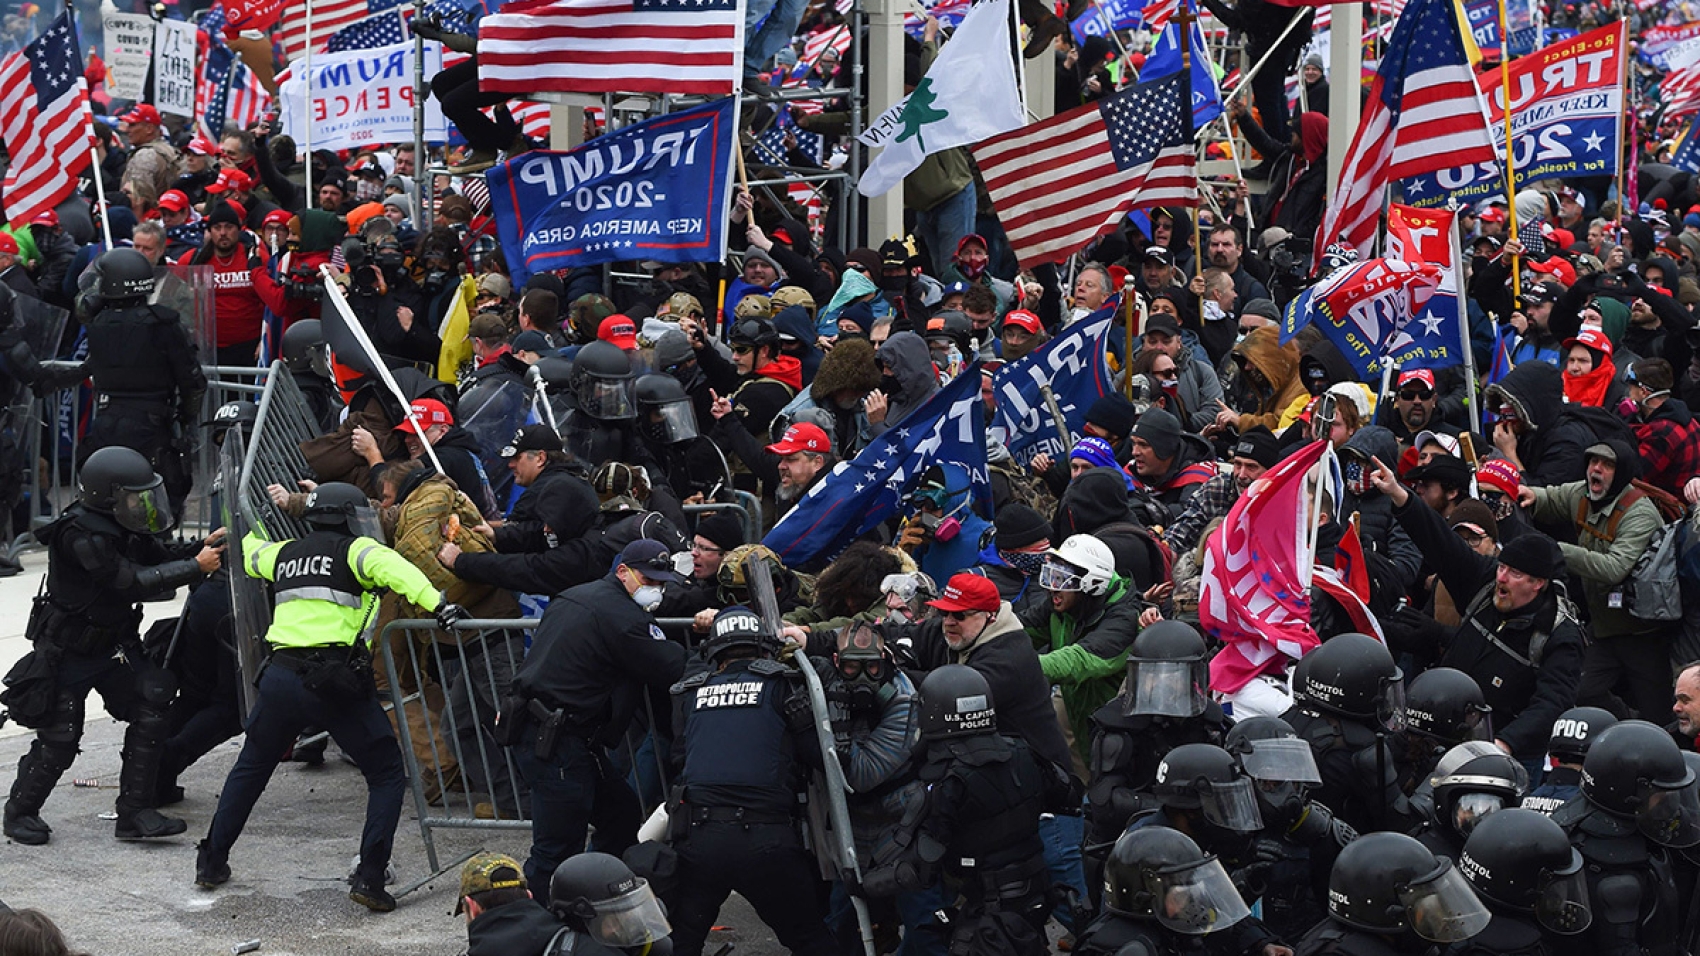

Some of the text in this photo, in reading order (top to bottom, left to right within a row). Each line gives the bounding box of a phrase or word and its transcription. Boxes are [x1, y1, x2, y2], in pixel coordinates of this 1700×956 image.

[277, 555, 334, 581] POLICE
[716, 615, 759, 637] MPDC
[696, 682, 763, 698] METROPOLITAN
[1305, 686, 1330, 702] POLICE
[1311, 680, 1345, 696] CAPITOL
[696, 693, 759, 709] POLICE
[944, 713, 963, 722] U.S.
[960, 718, 990, 729] POLICE
